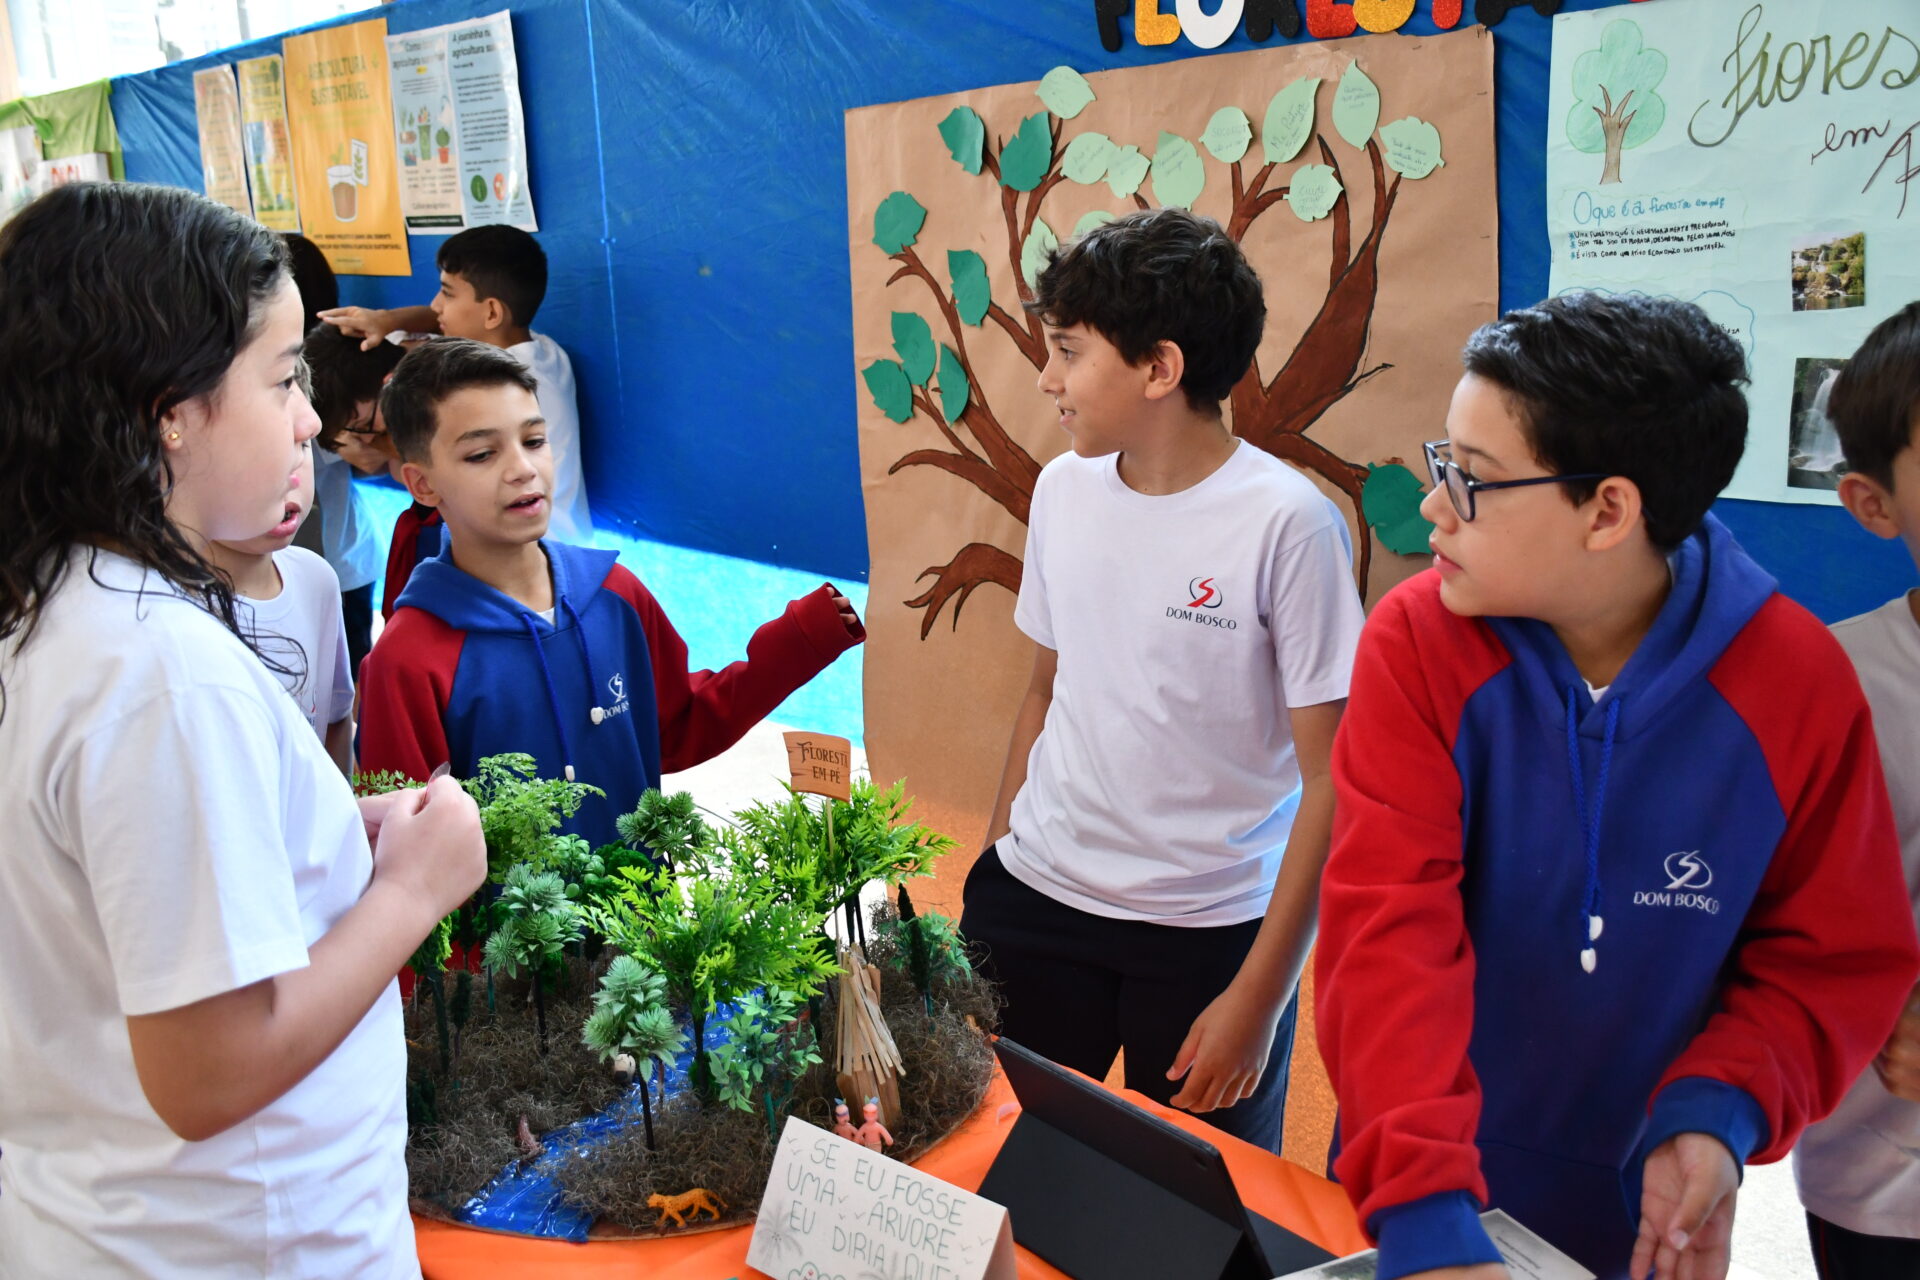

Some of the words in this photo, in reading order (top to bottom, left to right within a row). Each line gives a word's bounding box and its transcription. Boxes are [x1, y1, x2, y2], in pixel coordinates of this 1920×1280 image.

[1166, 606, 1192, 622] DOM
[1195, 613, 1237, 630] BOSCO
[812, 765, 827, 781] EM
[1633, 891, 1671, 907] DOM
[1674, 893, 1720, 915] BOSCO
[810, 1138, 841, 1170] SE
[854, 1158, 886, 1192] EU
[891, 1174, 967, 1226] FOSSE
[787, 1162, 837, 1206] UMA
[867, 1194, 957, 1260] ÁRVORE
[789, 1200, 816, 1235] EU
[832, 1225, 886, 1274] DIRIA
